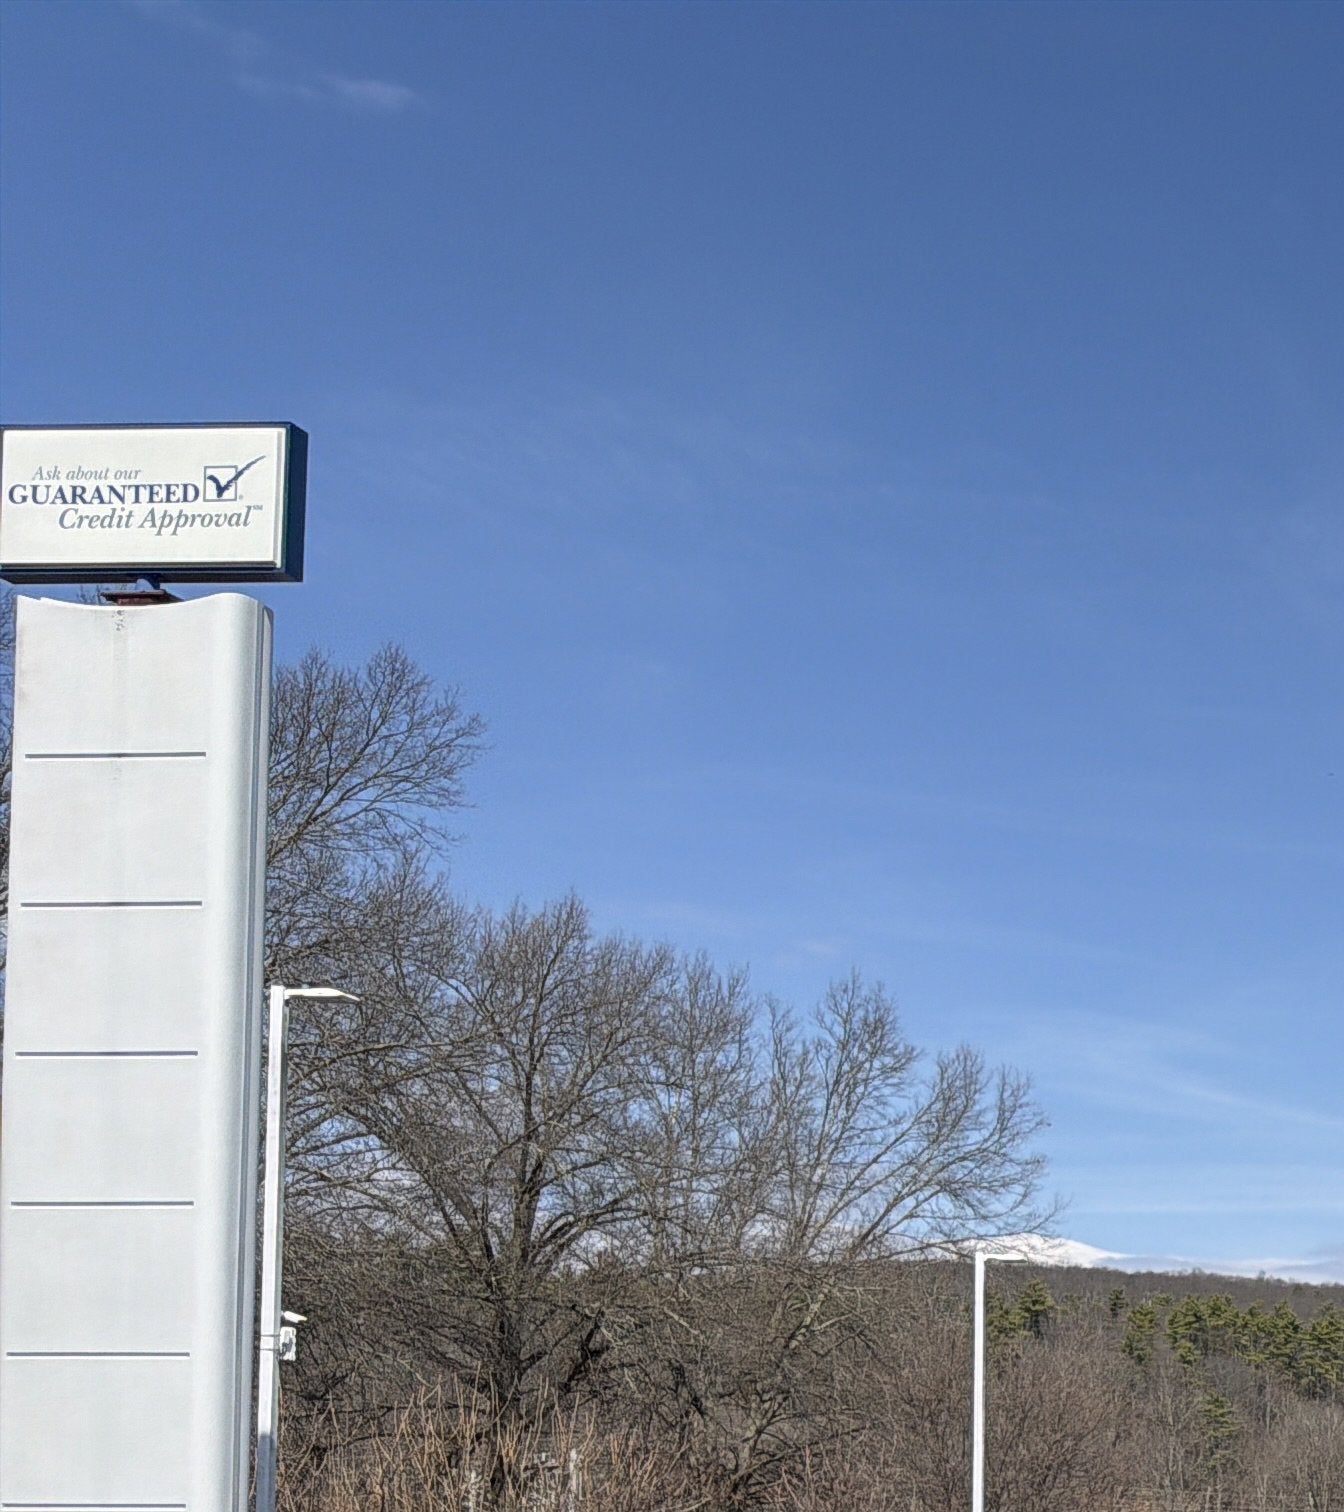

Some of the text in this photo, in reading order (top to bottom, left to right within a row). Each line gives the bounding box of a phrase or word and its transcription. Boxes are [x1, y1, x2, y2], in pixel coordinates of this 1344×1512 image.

[32, 466, 142, 481] Ask about our
[8, 482, 200, 505] GUARANTEED
[58, 507, 135, 530] Credit
[139, 505, 252, 536] Approval
